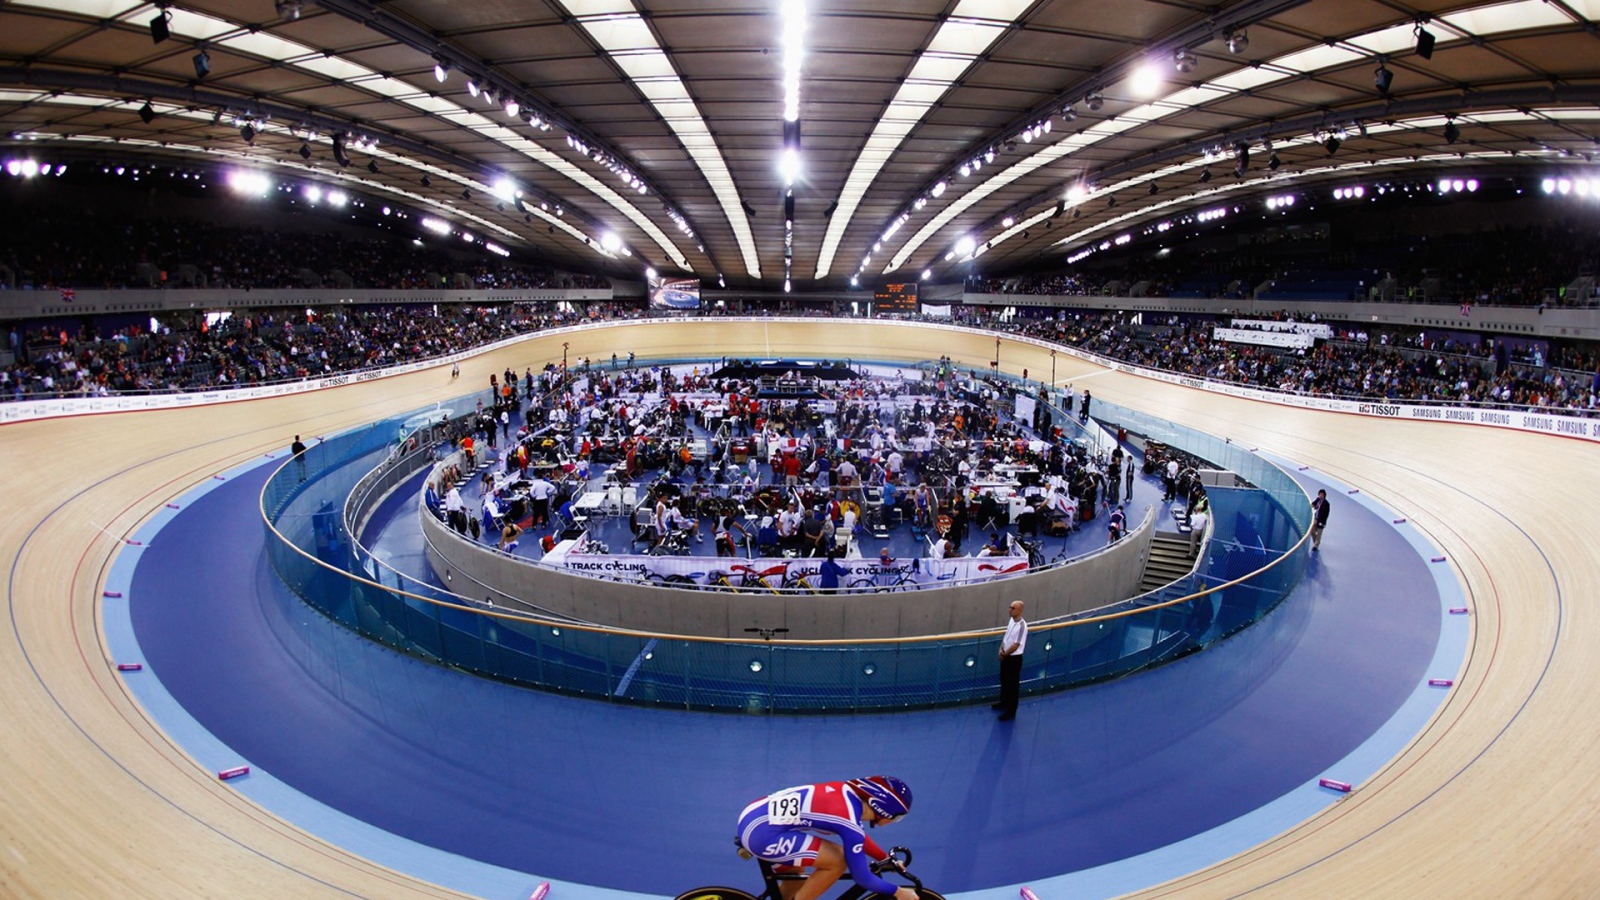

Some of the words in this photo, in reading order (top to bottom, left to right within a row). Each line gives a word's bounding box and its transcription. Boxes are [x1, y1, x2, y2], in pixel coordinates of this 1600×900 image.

[328, 376, 349, 388] TISSOT
[363, 371, 382, 381] TISSOT
[1187, 380, 1204, 389] TISSOT
[1371, 404, 1401, 416] TISSOT
[1412, 408, 1442, 419] SAMSUNG
[1445, 410, 1475, 421] SAMSUNG
[1480, 412, 1510, 425] SAMSUNG
[1523, 416, 1553, 431] SAMSUNG
[1557, 420, 1587, 436] SAMSUNG
[572, 563, 603, 571] TRACK
[605, 563, 646, 572] CYCLING
[856, 567, 901, 575] CYCLING
[771, 797, 799, 817] 193
